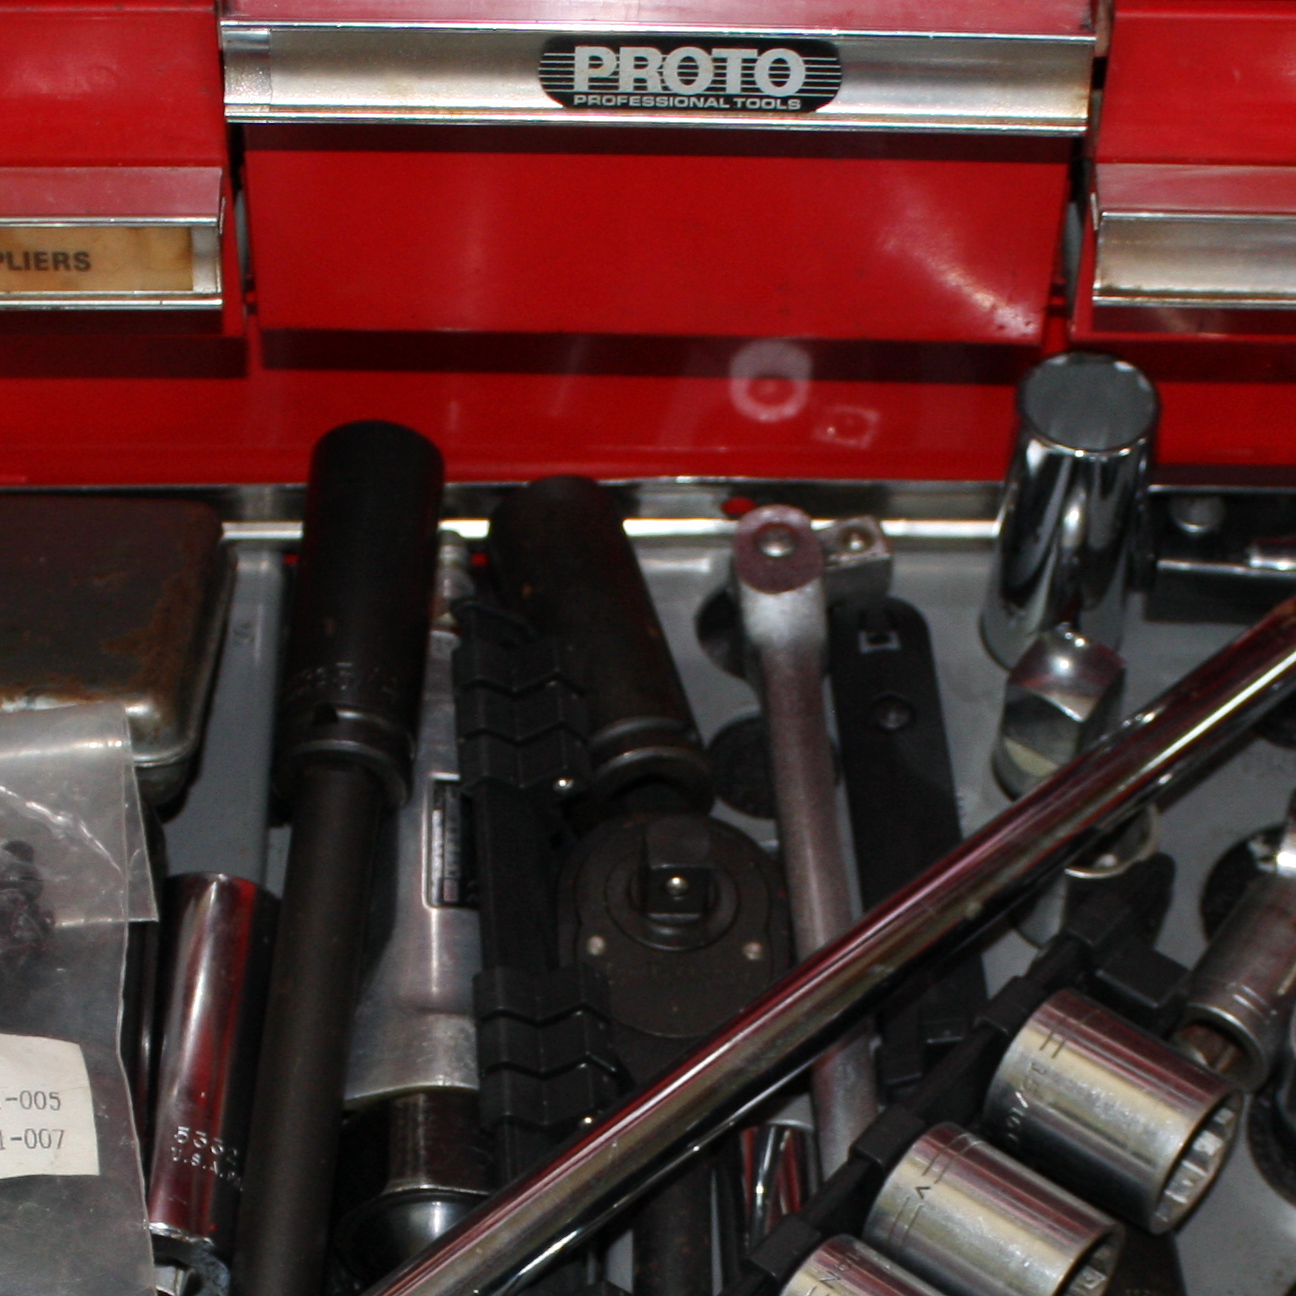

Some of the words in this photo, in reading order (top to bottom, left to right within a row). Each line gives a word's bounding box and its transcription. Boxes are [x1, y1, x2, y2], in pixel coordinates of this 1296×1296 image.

[573, 45, 806, 97] PROTO
[573, 94, 731, 109] PROFESSIONAL
[733, 96, 802, 111] TOOLS
